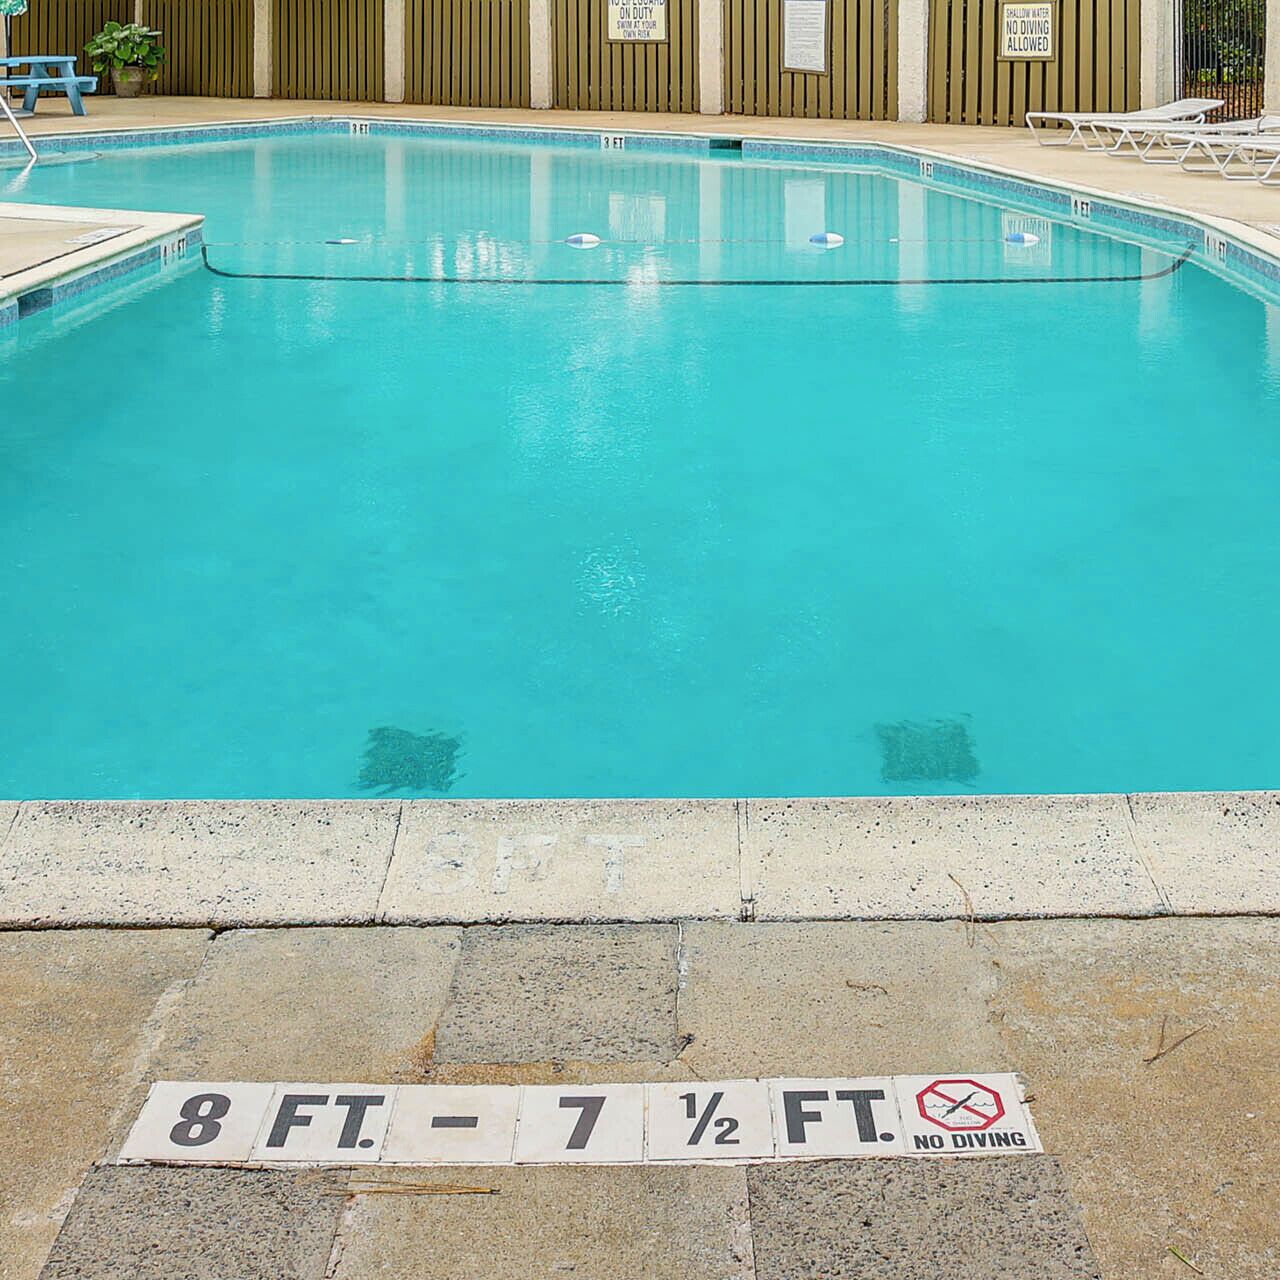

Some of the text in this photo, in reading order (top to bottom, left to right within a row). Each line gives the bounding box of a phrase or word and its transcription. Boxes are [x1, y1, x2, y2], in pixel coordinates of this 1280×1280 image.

[620, 7, 653, 20] ON DUTY
[1006, 8, 1049, 18] SHALLOW WATER
[617, 20, 657, 29] SWIM AT YOUR
[1006, 20, 1049, 35] NO DIVING
[1007, 36, 1049, 51] ALLOWED
[169, 1092, 232, 1147] 8
[265, 1094, 386, 1149] FT.
[430, 1115, 479, 1129] -
[558, 1095, 608, 1150] 7
[782, 1088, 896, 1145] FT.
[913, 1131, 1027, 1150] NO DIVING
